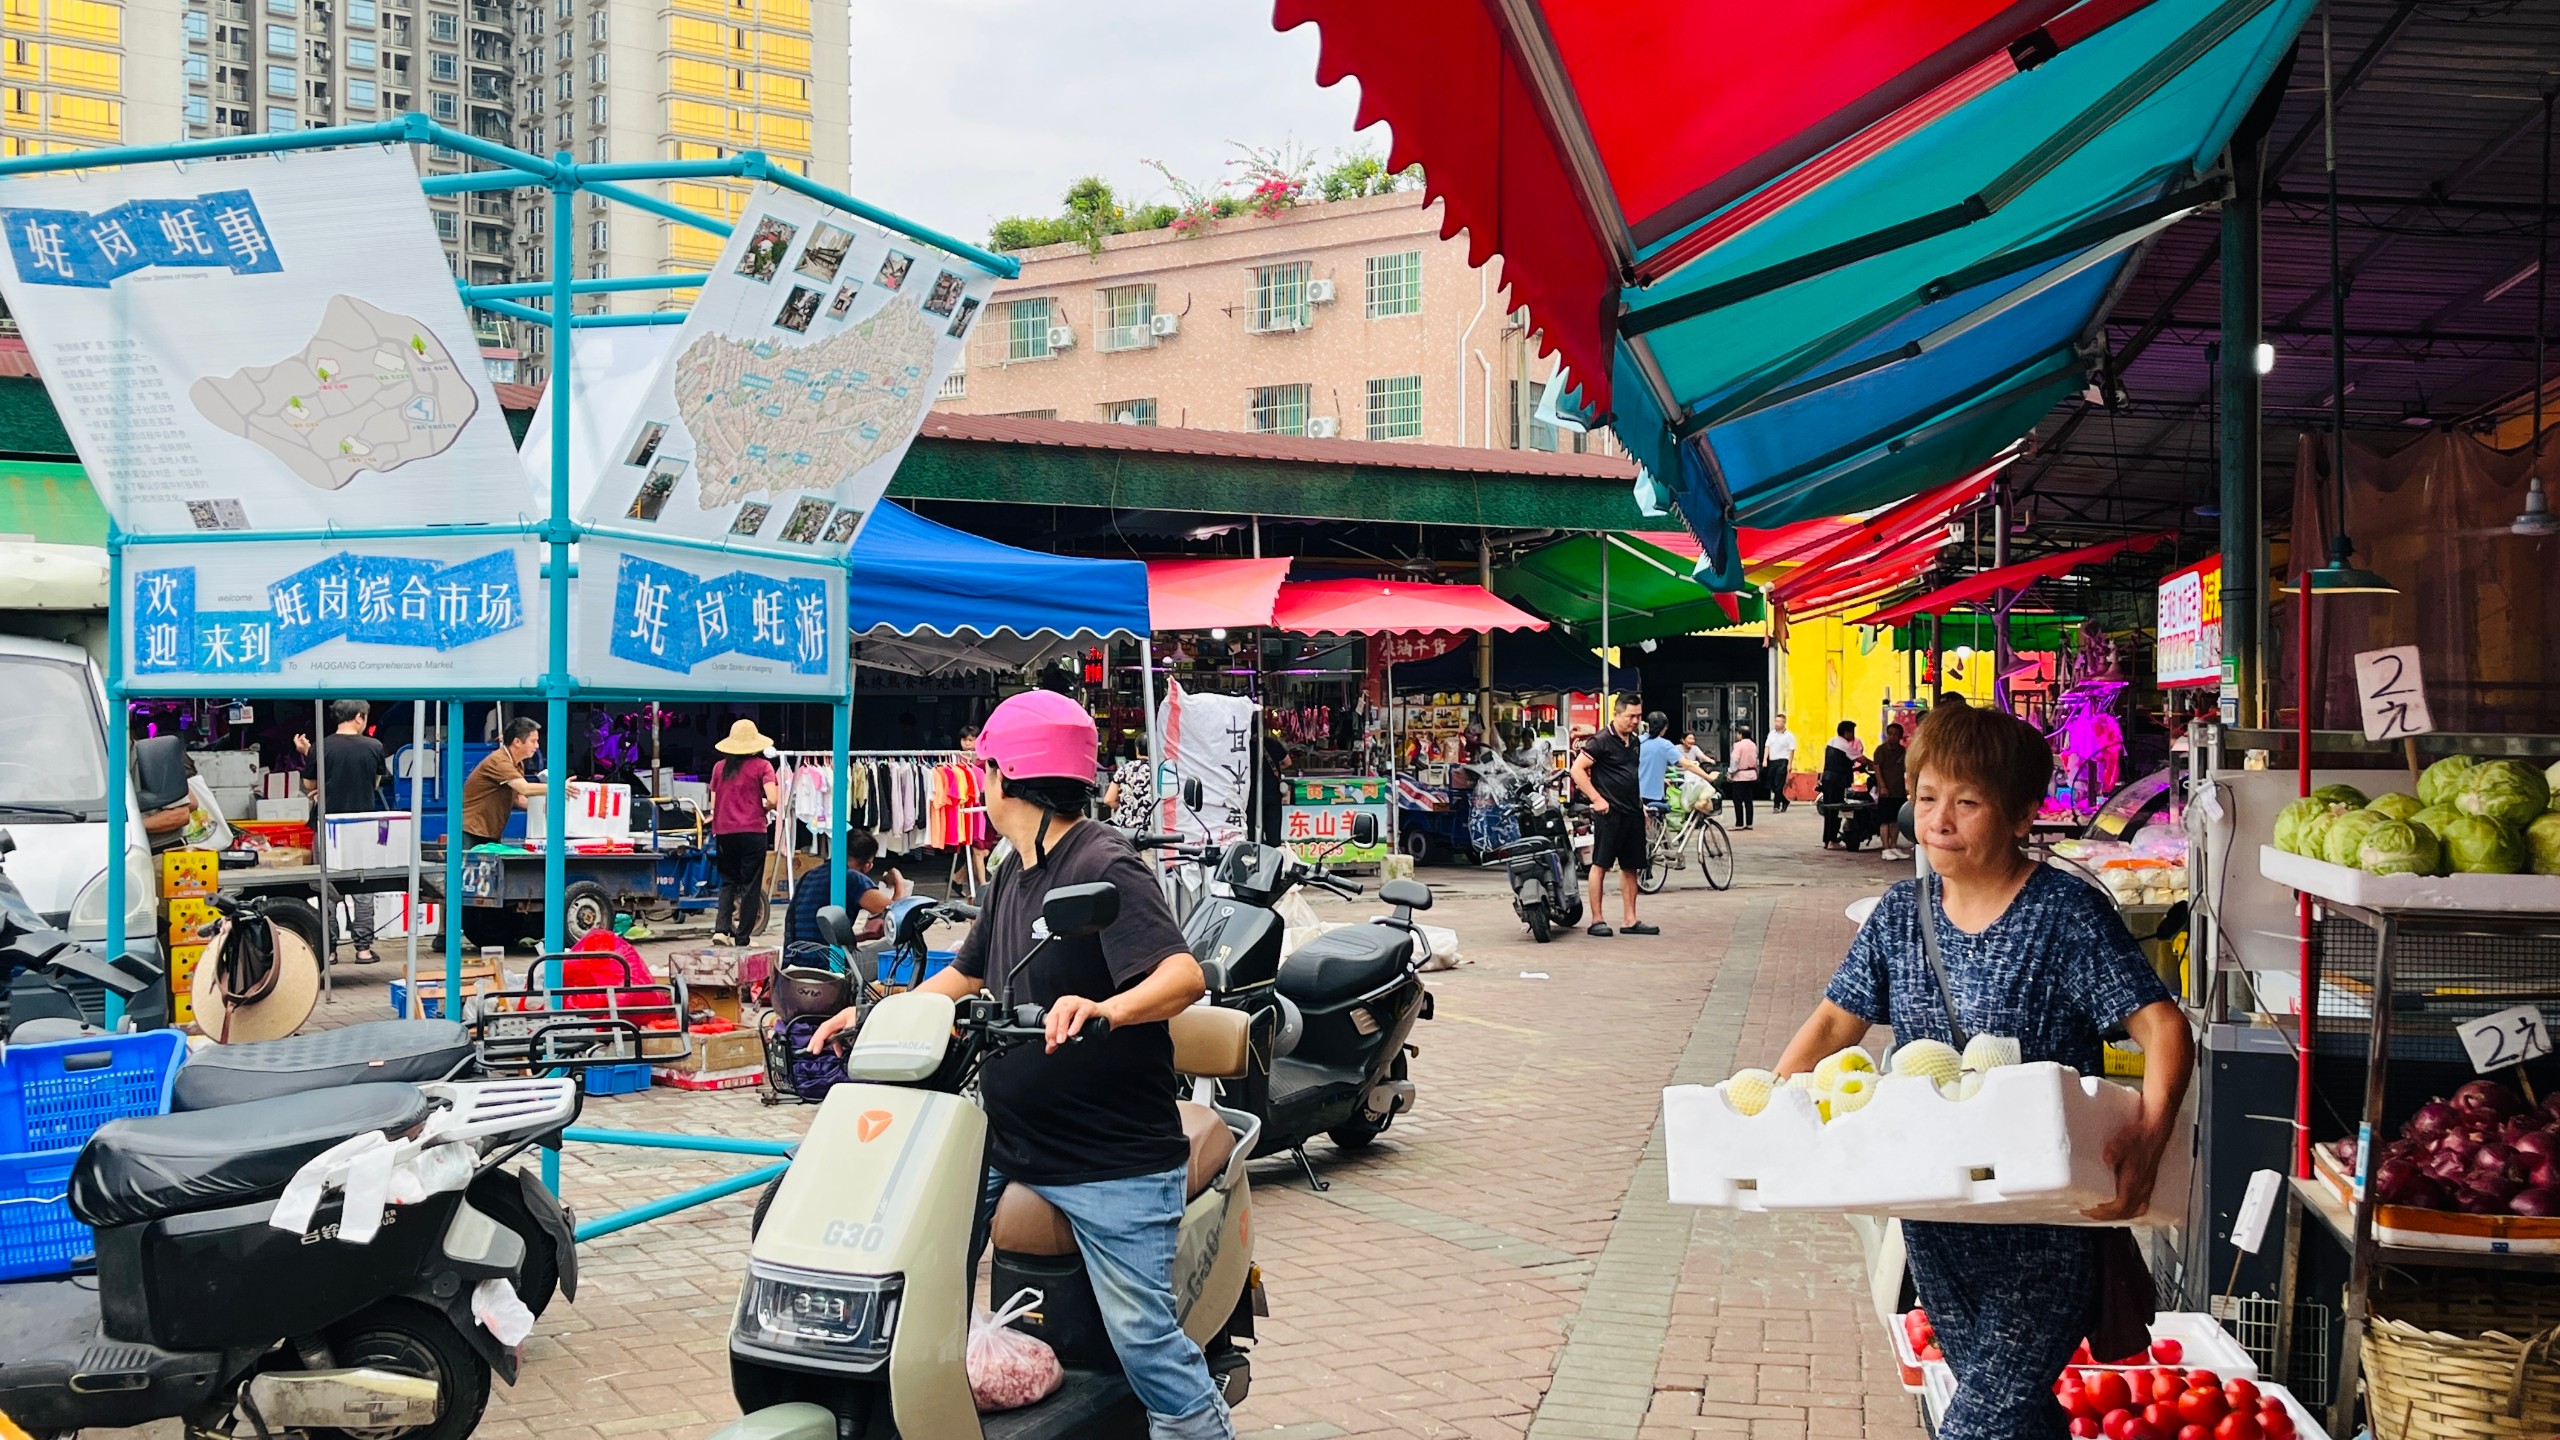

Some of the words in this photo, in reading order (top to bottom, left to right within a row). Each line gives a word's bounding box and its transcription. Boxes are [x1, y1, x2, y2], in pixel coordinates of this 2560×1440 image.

[25, 202, 268, 278] 蚝岗蚝事
[146, 575, 178, 667] 欢迎
[217, 593, 253, 603] welcome
[274, 574, 513, 631] 蚝岗综合市场
[630, 573, 825, 663] 蚝岗蚝游
[201, 621, 271, 668] 来到
[288, 660, 298, 670] To
[310, 660, 357, 671] HAOGANG
[358, 660, 423, 671] Comprehensive
[424, 660, 454, 670] Market
[711, 661, 727, 674] Oyster
[746, 663, 752, 673] of
[823, 1219, 885, 1252] G30
